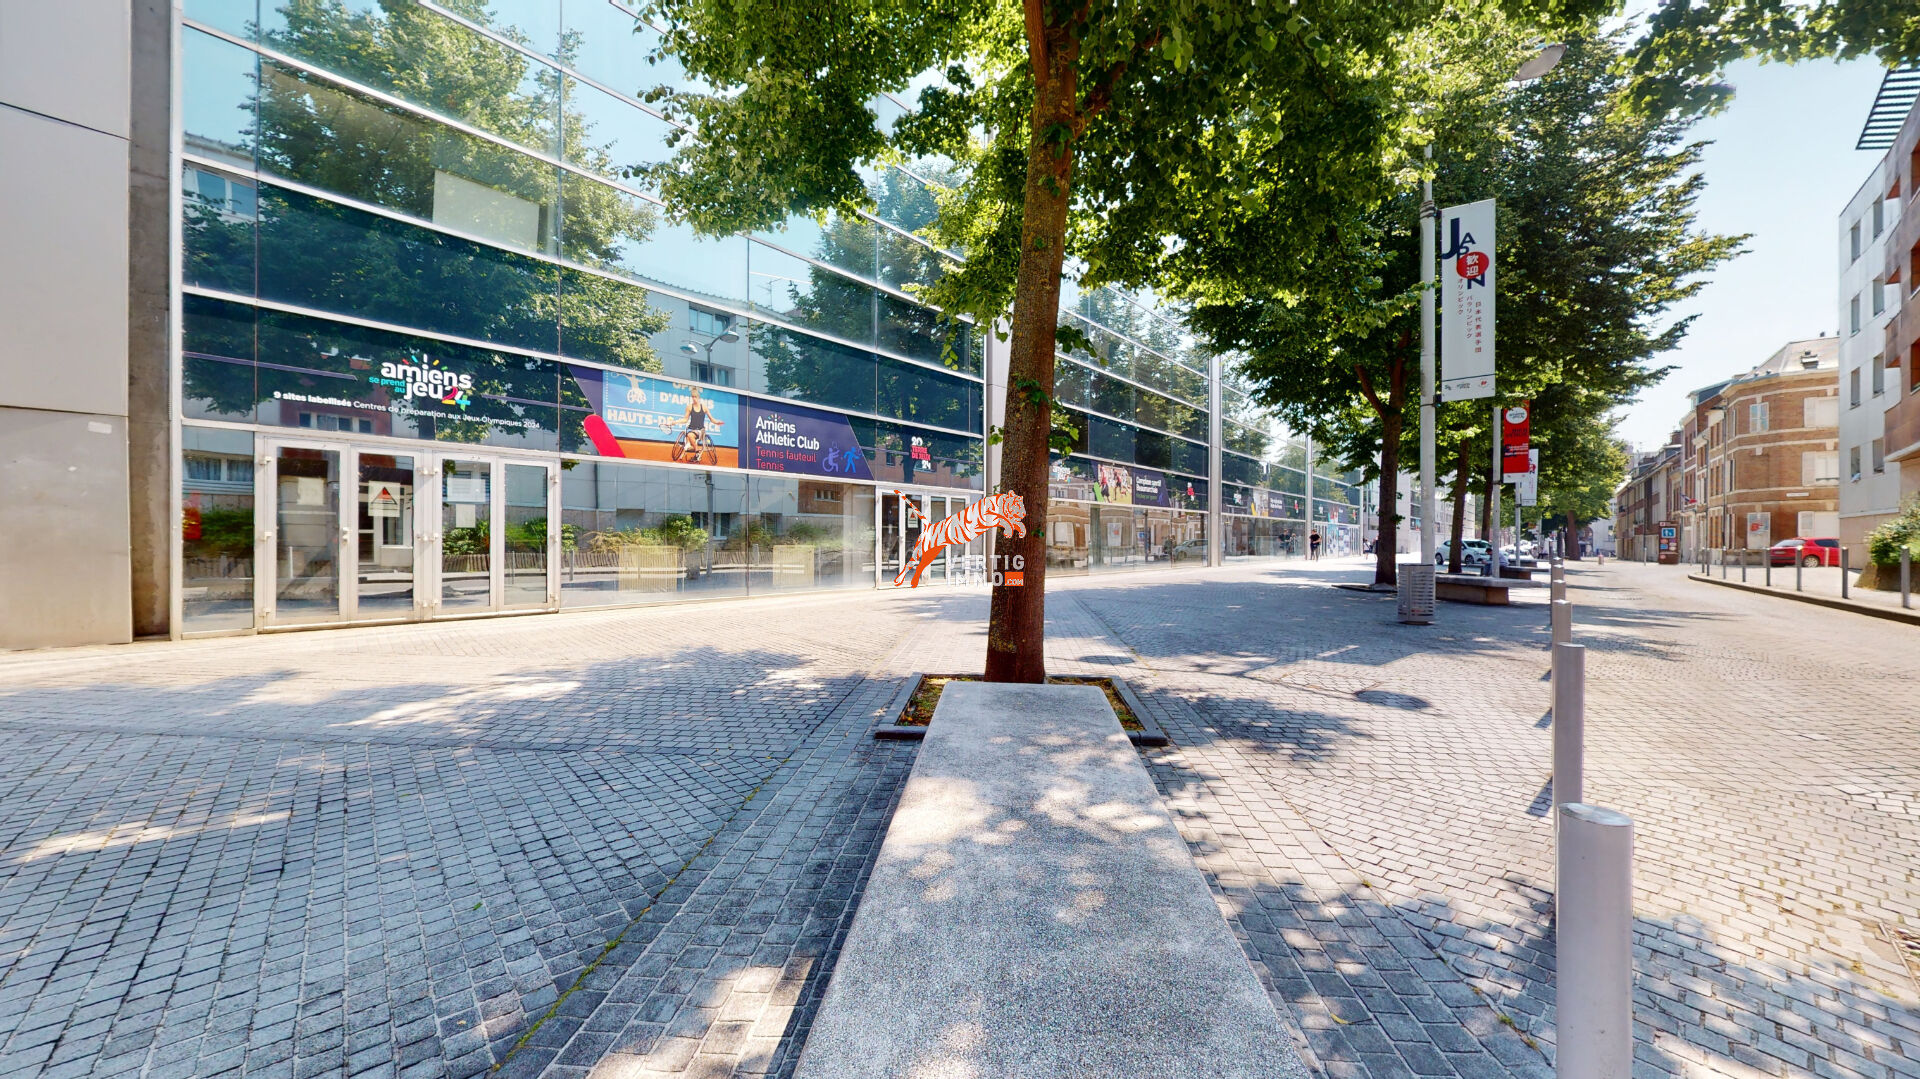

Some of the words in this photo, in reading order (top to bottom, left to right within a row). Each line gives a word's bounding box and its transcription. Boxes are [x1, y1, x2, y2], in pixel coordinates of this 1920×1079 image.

[380, 354, 472, 389] amiens
[368, 376, 380, 384] se
[380, 378, 406, 388] prend
[394, 386, 406, 394] au
[273, 390, 282, 399] 9
[282, 392, 307, 402] sites
[308, 394, 353, 407] labellisés
[353, 401, 387, 413] Centres
[387, 405, 399, 414] de
[400, 407, 446, 419] préparation
[523, 421, 541, 429] 2024
[755, 414, 796, 434] Amiens
[755, 430, 796, 448] Athletic
[796, 436, 820, 451] Club
[911, 436, 923, 447] 20
[756, 446, 785, 459] Tennis
[786, 450, 817, 463] fauteuil
[755, 459, 785, 471] Tennis
